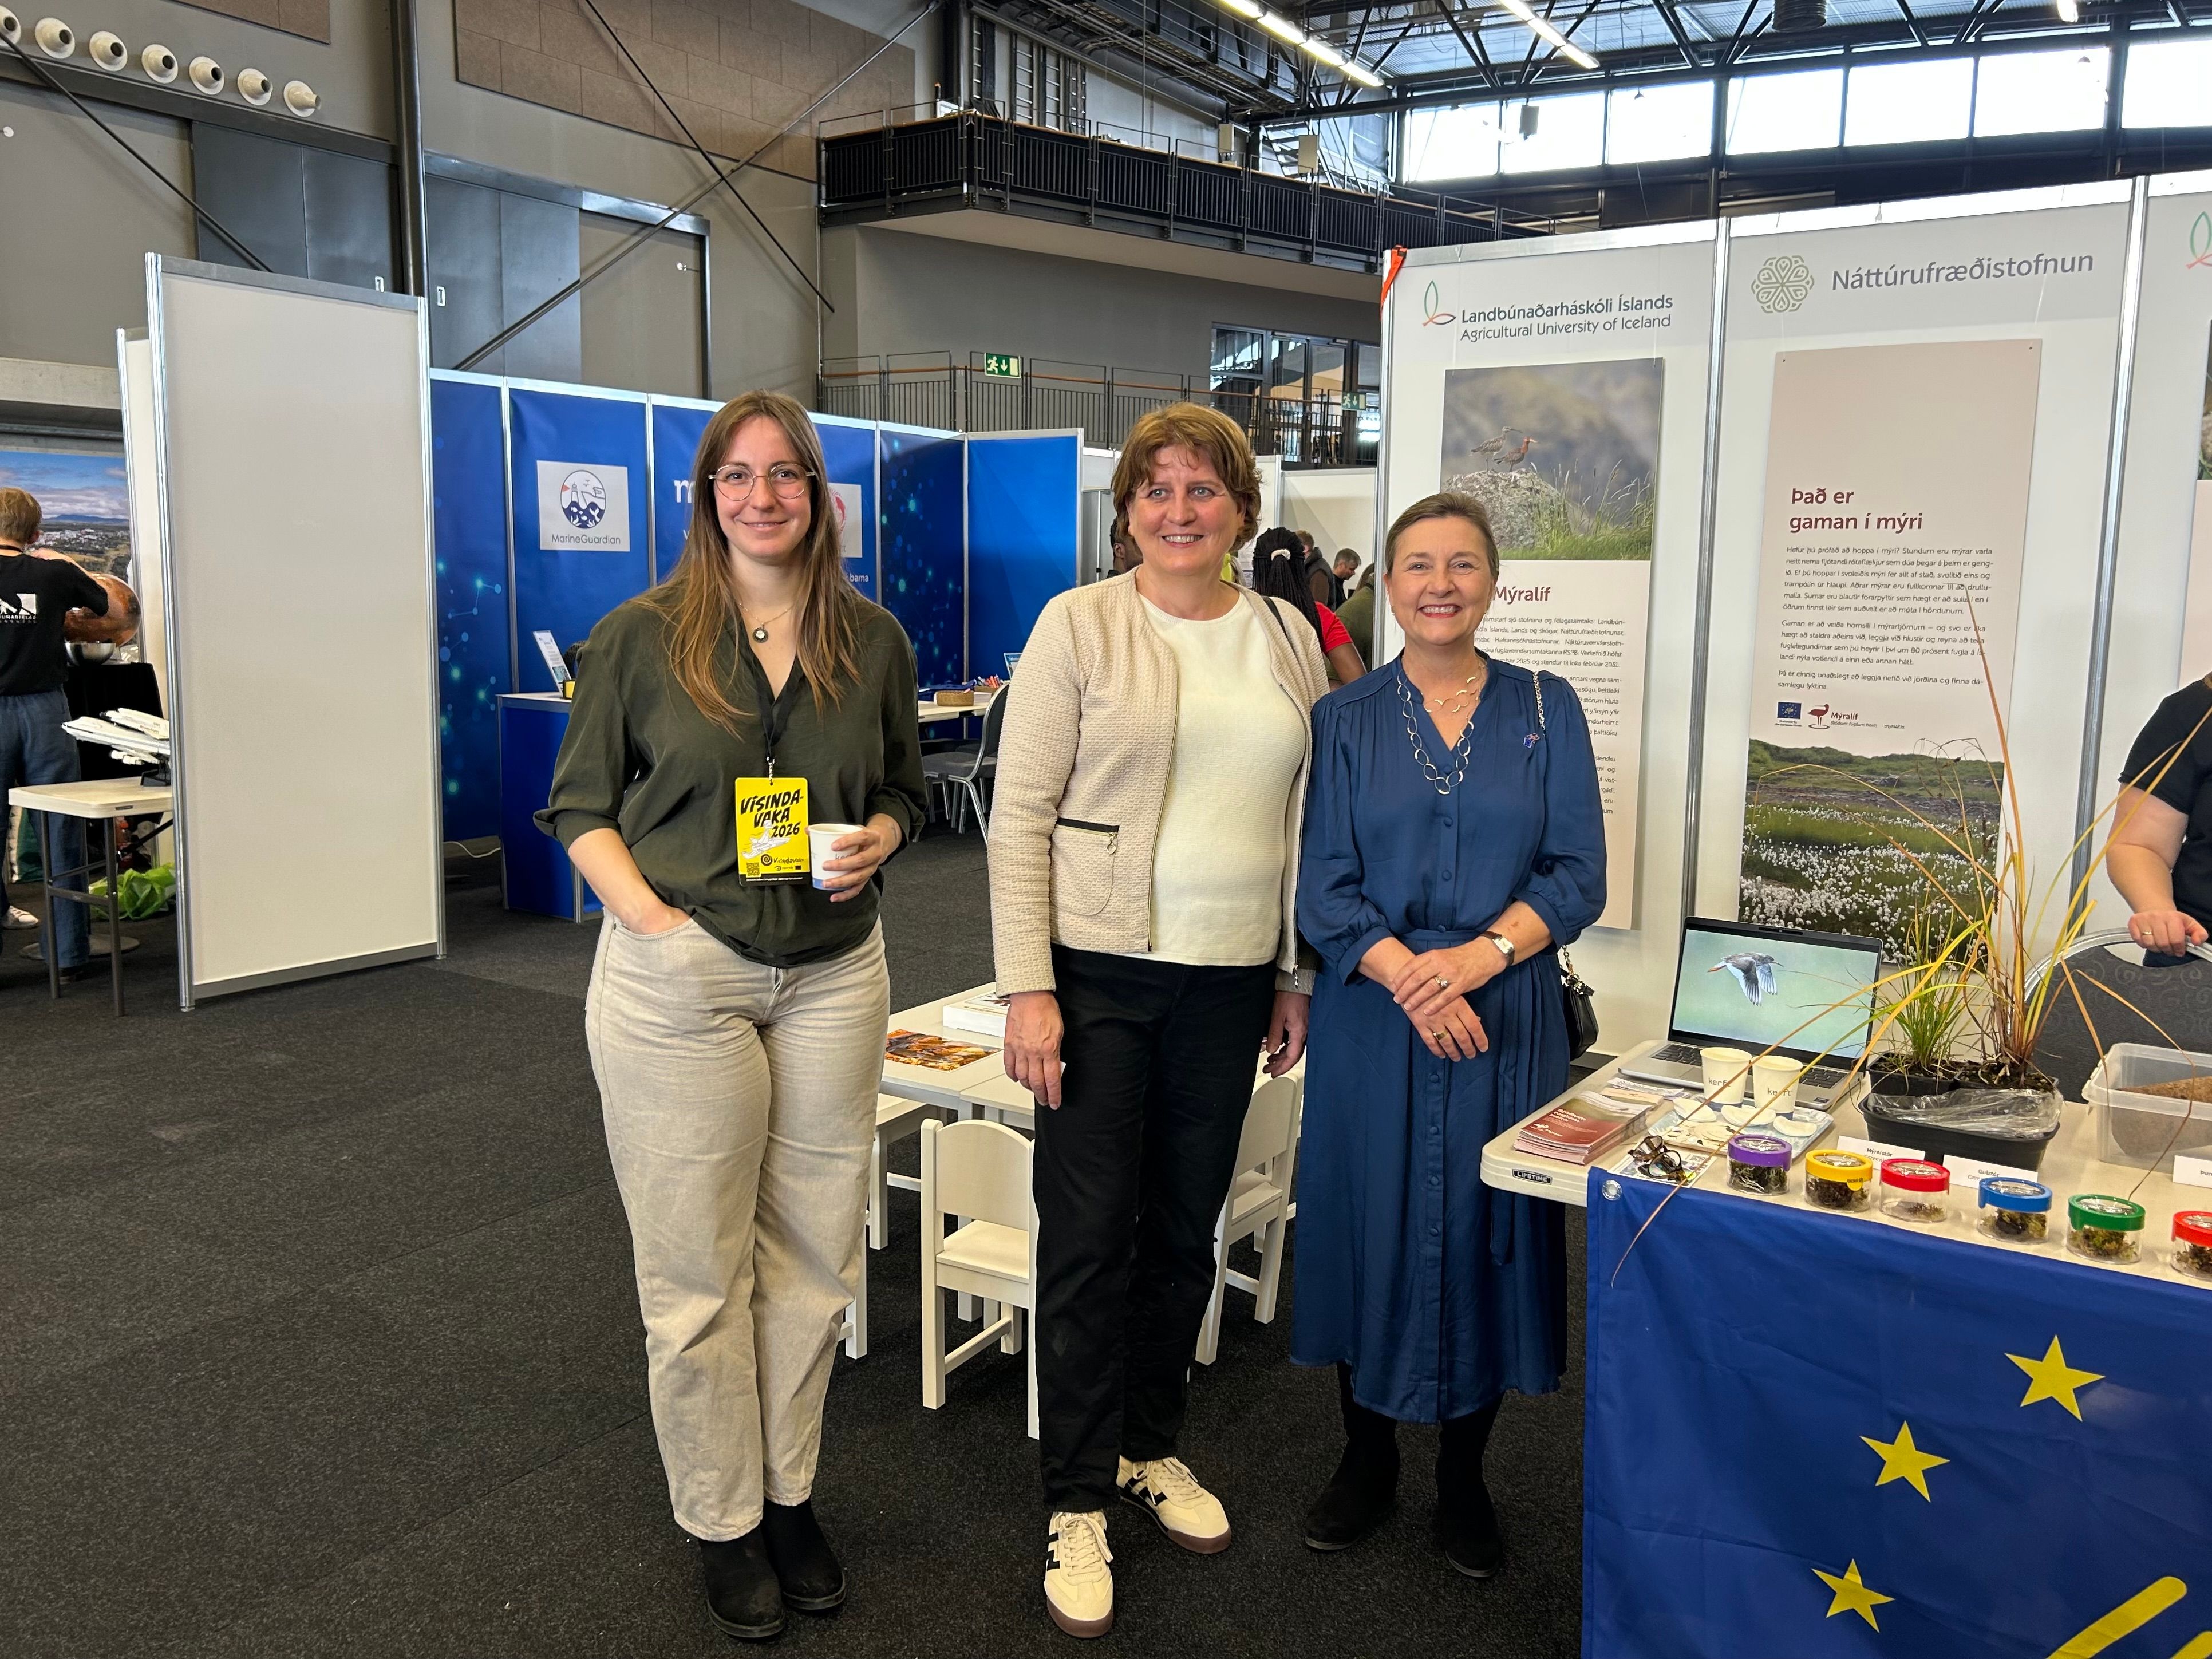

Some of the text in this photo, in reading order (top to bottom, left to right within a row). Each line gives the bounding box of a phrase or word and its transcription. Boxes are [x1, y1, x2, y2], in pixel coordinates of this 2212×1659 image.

[1832, 252, 2094, 290] Náttúrufræðistofnun
[1462, 294, 1674, 324] Landbúnaðarháskóli Íslands
[1460, 314, 1672, 342] Agricultural University of Iceland
[1791, 488, 1854, 505] Það er
[1789, 512, 1923, 534] gaman í mýri
[551, 534, 621, 544] MarineGuardian
[1818, 547, 1839, 555] prófað
[1852, 547, 1874, 555] hoppa
[1881, 547, 1900, 555] mýri?
[1952, 548, 1973, 556] mýrar
[1821, 558, 1847, 566] fljótandi
[1916, 559, 1937, 567] þegar
[1943, 559, 1961, 568] þeim
[1812, 570, 1836, 578] hoppar
[1870, 582, 1891, 590] mýrar
[1494, 586, 1551, 605] Mýralíf
[1913, 595, 1931, 603] hægt
[1878, 623, 1925, 631] mýrartjörnum
[1781, 631, 1798, 639] hægt
[1869, 634, 1889, 642] leggja
[1861, 645, 1880, 654] heyrir
[1950, 648, 1969, 657] fugla
[1796, 671, 1816, 679] einnig
[1861, 674, 1881, 682] leggja
[1778, 682, 1804, 690] samlegu
[1831, 712, 1859, 720] Mýralíf
[753, 806, 790, 828] VAKA
[771, 821, 801, 838] 2026
[1708, 1077, 1731, 1087] kerf
[1767, 1088, 1791, 1096] keft
